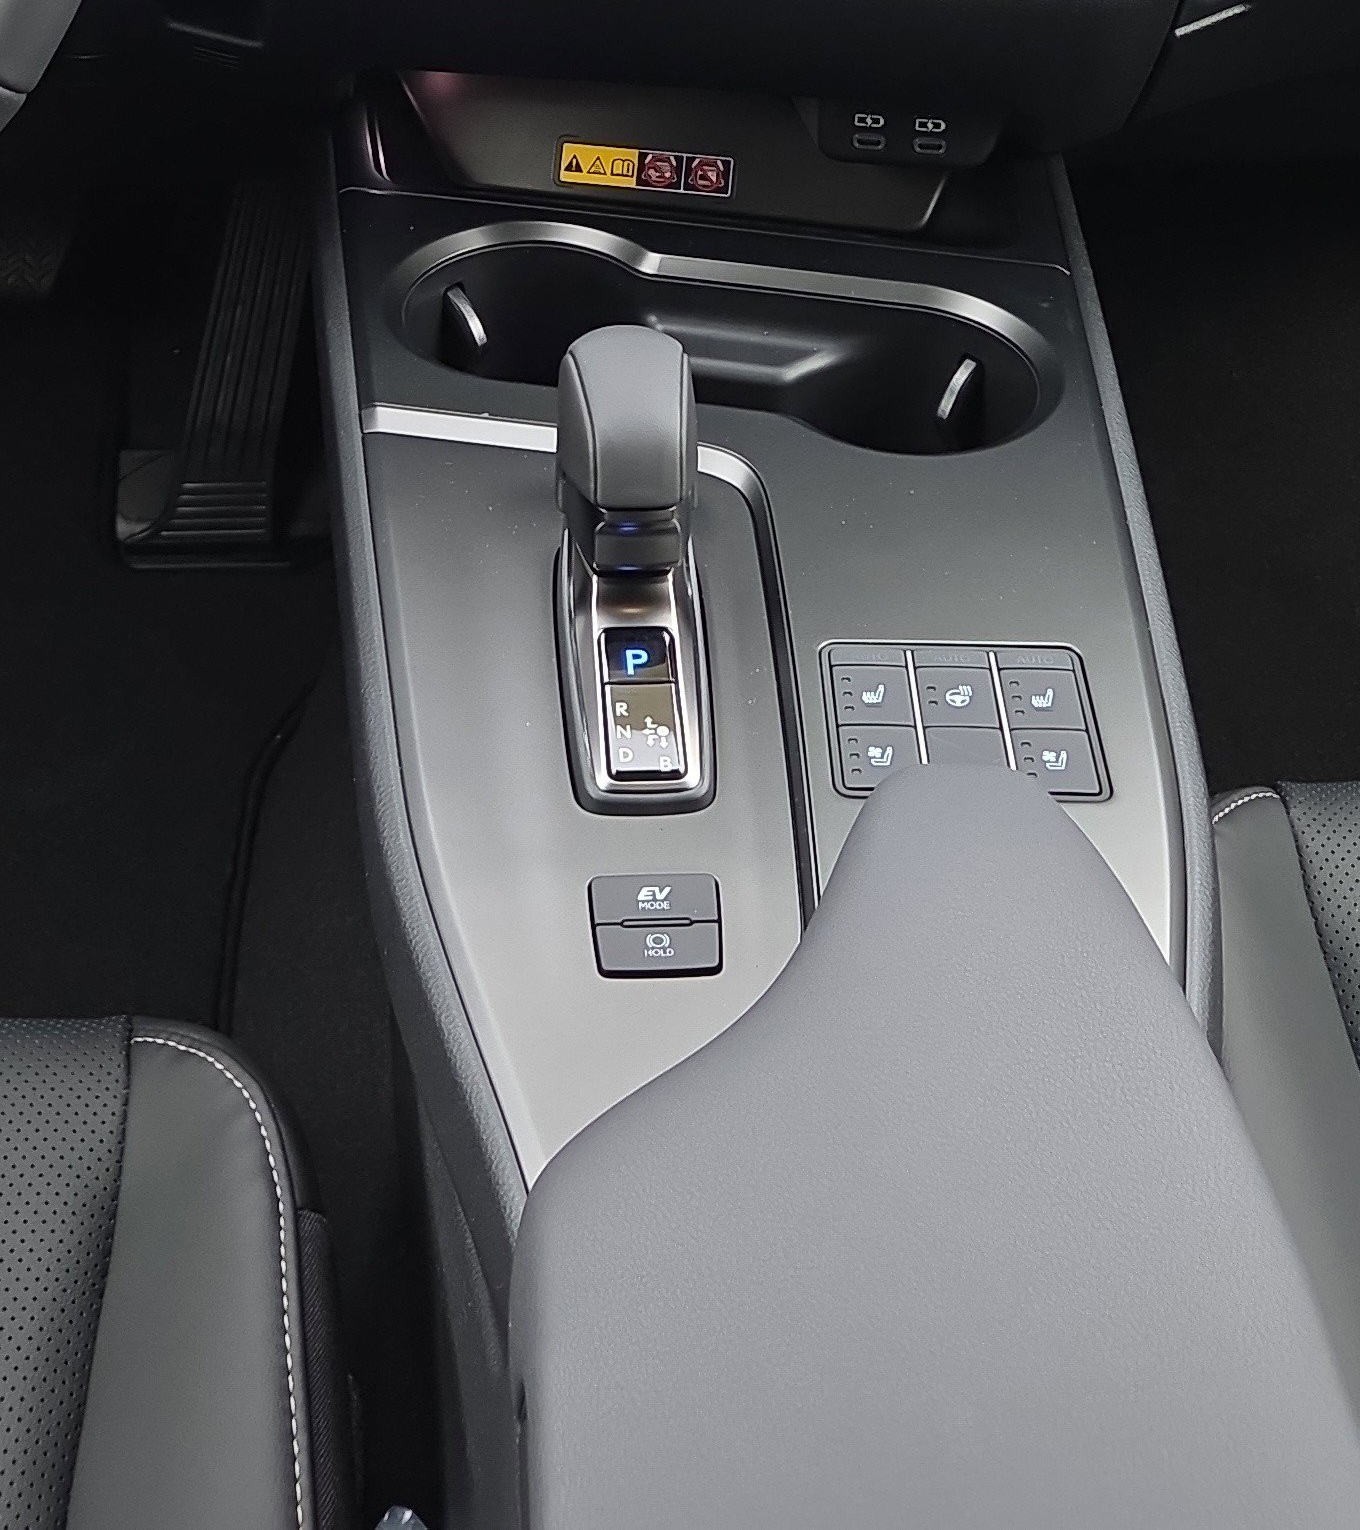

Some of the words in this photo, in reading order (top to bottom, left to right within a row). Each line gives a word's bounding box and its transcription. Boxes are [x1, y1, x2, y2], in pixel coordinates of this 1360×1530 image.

[624, 648, 648, 676] P
[615, 701, 629, 718] R
[616, 725, 631, 740] N
[618, 746, 634, 764] D
[659, 755, 672, 773] B
[637, 885, 672, 902] EV
[638, 901, 671, 911] MODE
[643, 945, 675, 958] HOLD
